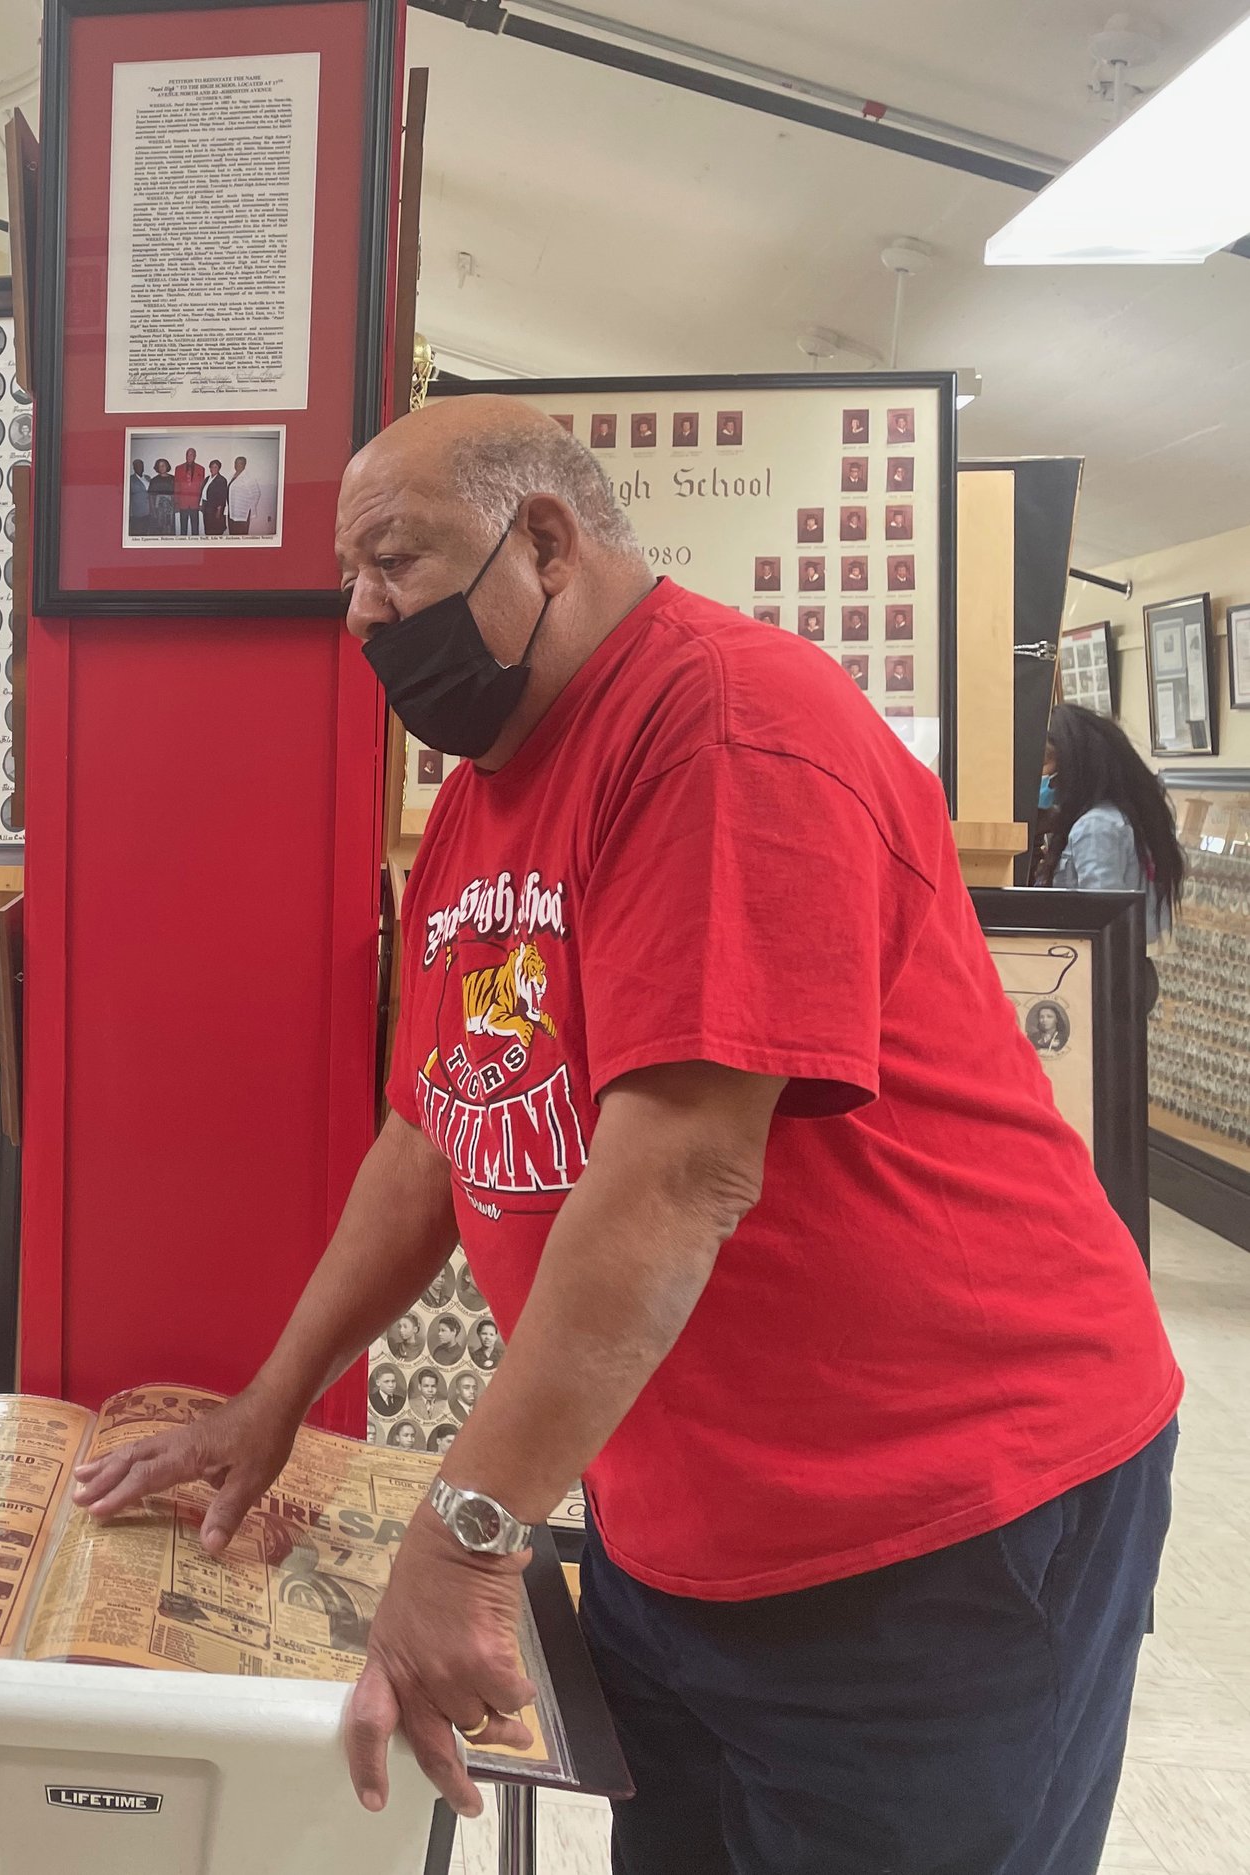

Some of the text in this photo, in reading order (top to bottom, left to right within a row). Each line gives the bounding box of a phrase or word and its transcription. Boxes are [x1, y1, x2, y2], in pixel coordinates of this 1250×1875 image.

[608, 467, 771, 507] igh School
[338, 1509, 408, 1546] SA
[60, 1790, 147, 1809] LIFETIME
